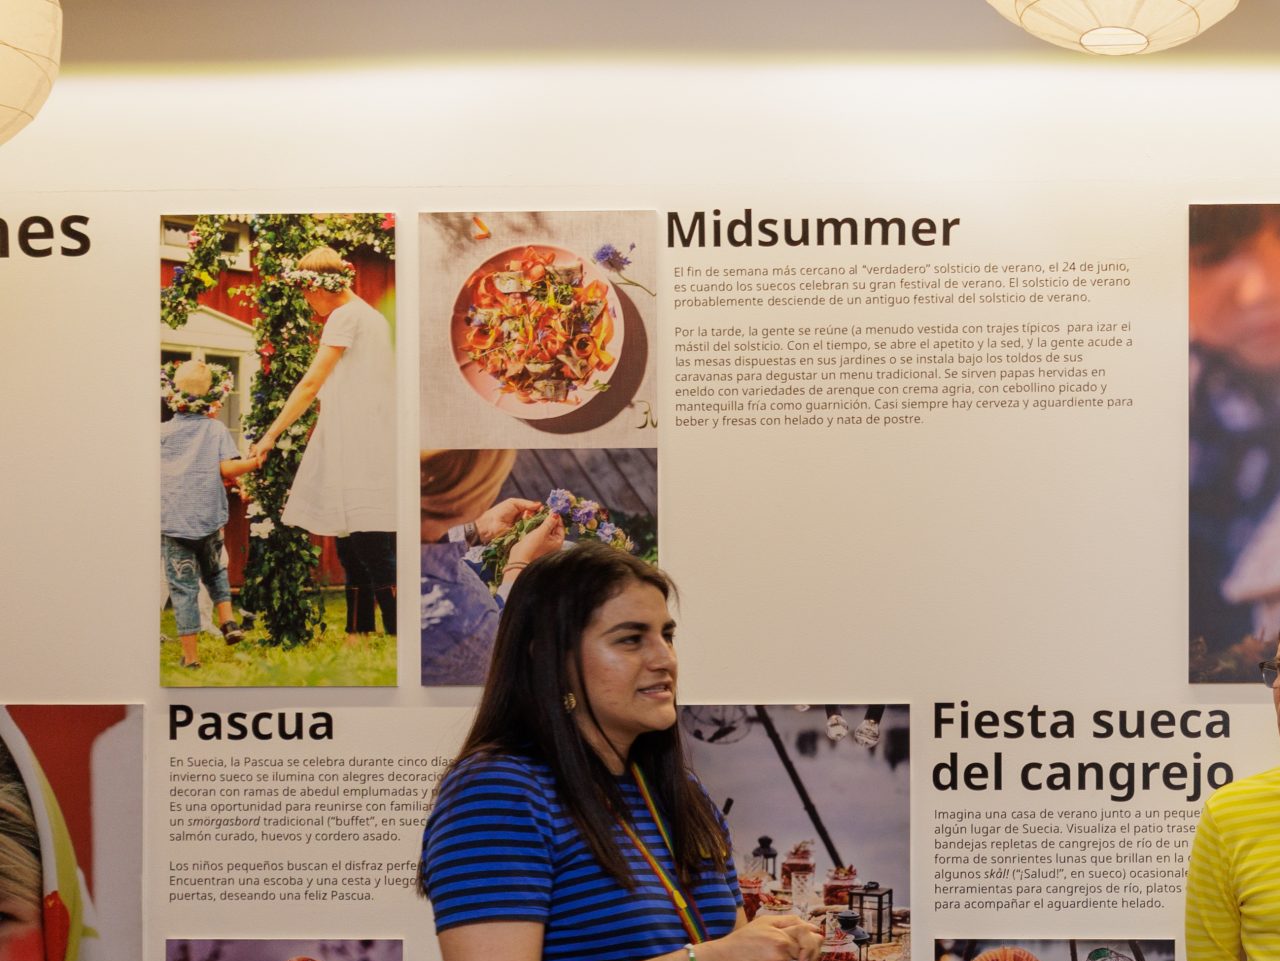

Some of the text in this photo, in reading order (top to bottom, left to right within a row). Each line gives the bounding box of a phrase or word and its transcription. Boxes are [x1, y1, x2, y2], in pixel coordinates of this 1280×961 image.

[667, 209, 961, 248] Midsummer
[674, 265, 684, 277] El
[686, 265, 702, 277] fin
[705, 264, 720, 277] de
[723, 268, 768, 277] semana
[772, 263, 796, 276] más
[799, 267, 846, 276] cercano
[848, 263, 857, 275] al
[933, 261, 980, 274] solsticio
[983, 261, 998, 273] de
[1001, 264, 1044, 275] verano,
[1048, 260, 1058, 273] el
[1062, 260, 1076, 272] 24
[1079, 260, 1094, 272] de
[673, 275, 1130, 293] es cuando los suecos celebran su gran festival de verano. El solsticio de verano
[674, 290, 1090, 311] probablemente desciende de un antiguo festival del solsticio de verano.
[169, 704, 334, 741] Pascua
[934, 700, 1230, 739] Fiesta sueca
[169, 755, 184, 766] En
[187, 755, 227, 769] Suecia,
[230, 755, 240, 766] la
[243, 755, 284, 766] Pascua
[302, 755, 345, 766] celebra
[348, 755, 394, 766] durante
[397, 755, 428, 766] cinco
[932, 752, 1234, 802] del cangrejo
[169, 800, 182, 811] Es
[210, 800, 282, 815] oportunidad
[285, 804, 311, 815] para
[314, 800, 362, 811] reunirse
[934, 807, 981, 822] Imagina
[1039, 807, 1054, 818] de
[1099, 807, 1131, 822] junto
[1163, 811, 1202, 822] peque
[934, 822, 966, 837] algún
[970, 822, 1001, 837] lugar
[1004, 822, 1019, 833] de
[1022, 822, 1062, 833] Suecia.
[1066, 822, 1116, 833] Visualiza
[1120, 822, 1130, 833] el
[1133, 822, 1163, 837] patio
[169, 830, 402, 845] salmón curado, huevos y cordero asado.
[934, 837, 987, 852] bandejas
[990, 837, 1037, 852] repletas
[1040, 837, 1055, 848] de
[1058, 837, 1115, 852] cangrejos
[1118, 837, 1133, 848] de
[1136, 837, 1152, 848] río
[1155, 837, 1170, 848] de
[169, 859, 188, 870] Los
[192, 859, 223, 870] niños
[226, 859, 284, 874] pequeños
[287, 859, 328, 870] buscan
[331, 859, 341, 870] el
[344, 859, 383, 870] disfraz
[169, 891, 216, 904] puertas,
[219, 889, 276, 900] deseando
[304, 889, 327, 900] feliz
[330, 889, 376, 900] Pascua.
[934, 882, 1182, 897] herramientas para cangrejos de río, platos
[934, 897, 1166, 912] para acompañar el aguardiente helado.
